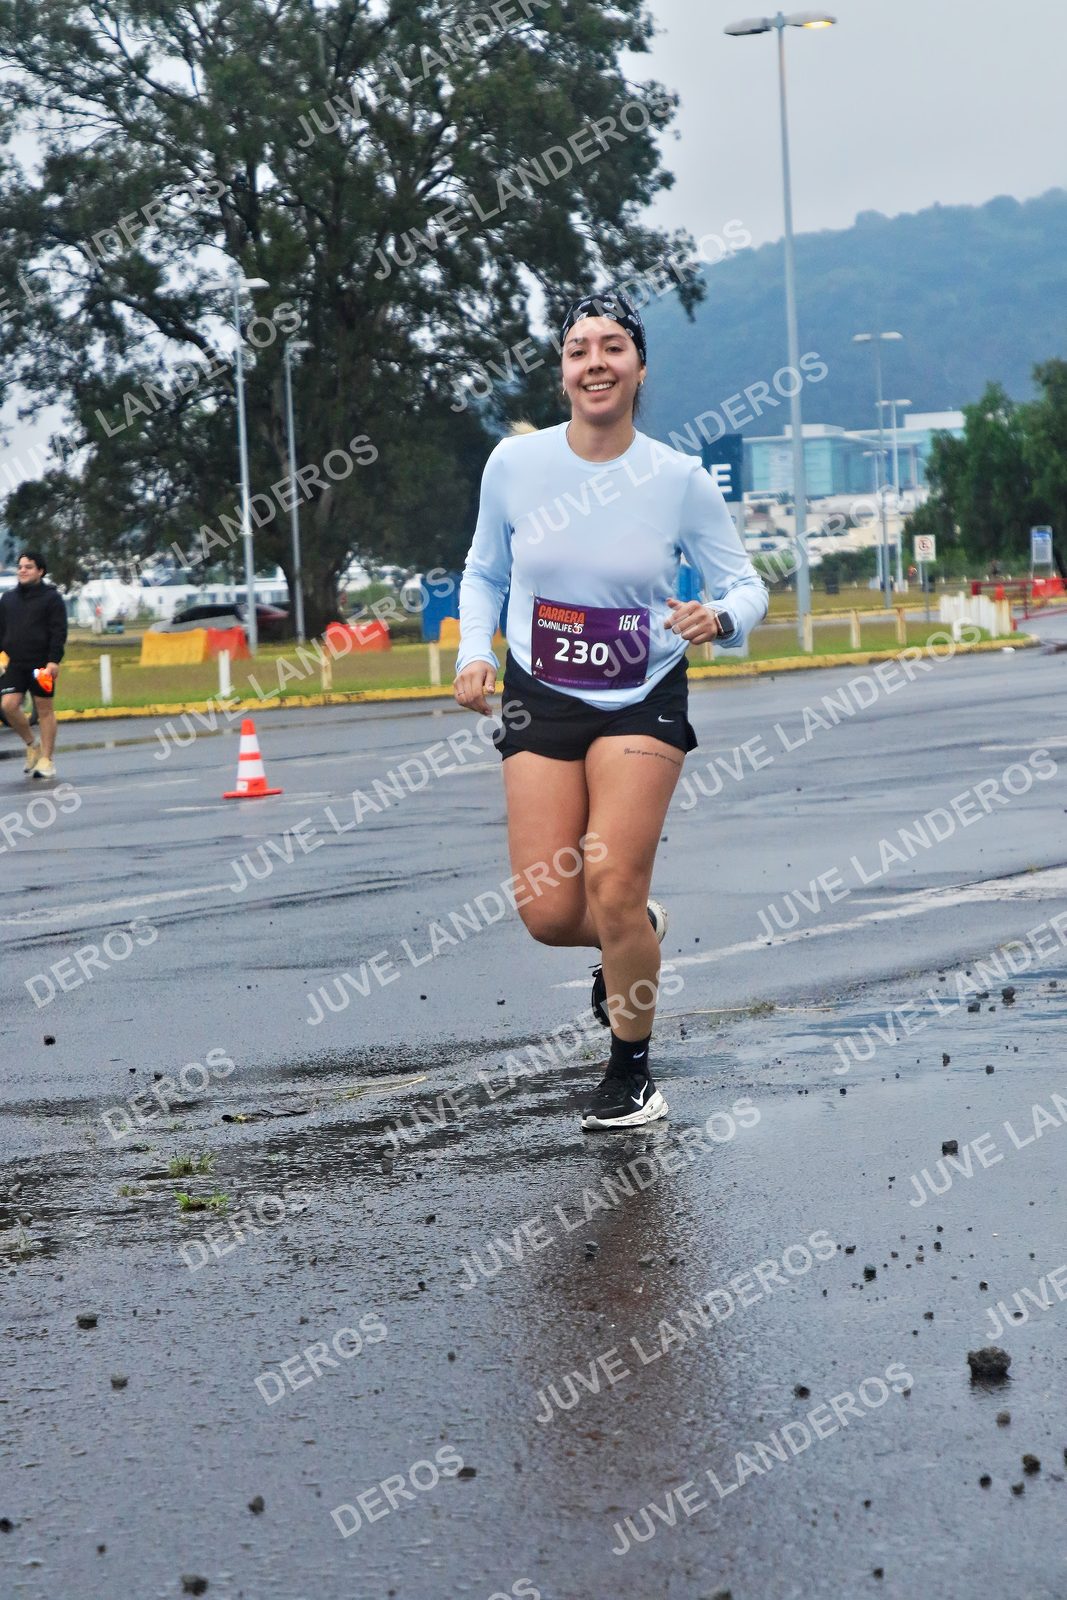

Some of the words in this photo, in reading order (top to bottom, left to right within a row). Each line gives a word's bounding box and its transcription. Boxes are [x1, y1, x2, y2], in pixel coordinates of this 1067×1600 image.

[538, 605, 586, 624] CARRERA
[618, 615, 640, 631] 15K
[538, 619, 572, 633] OMNILIFE
[554, 637, 609, 666] 230
